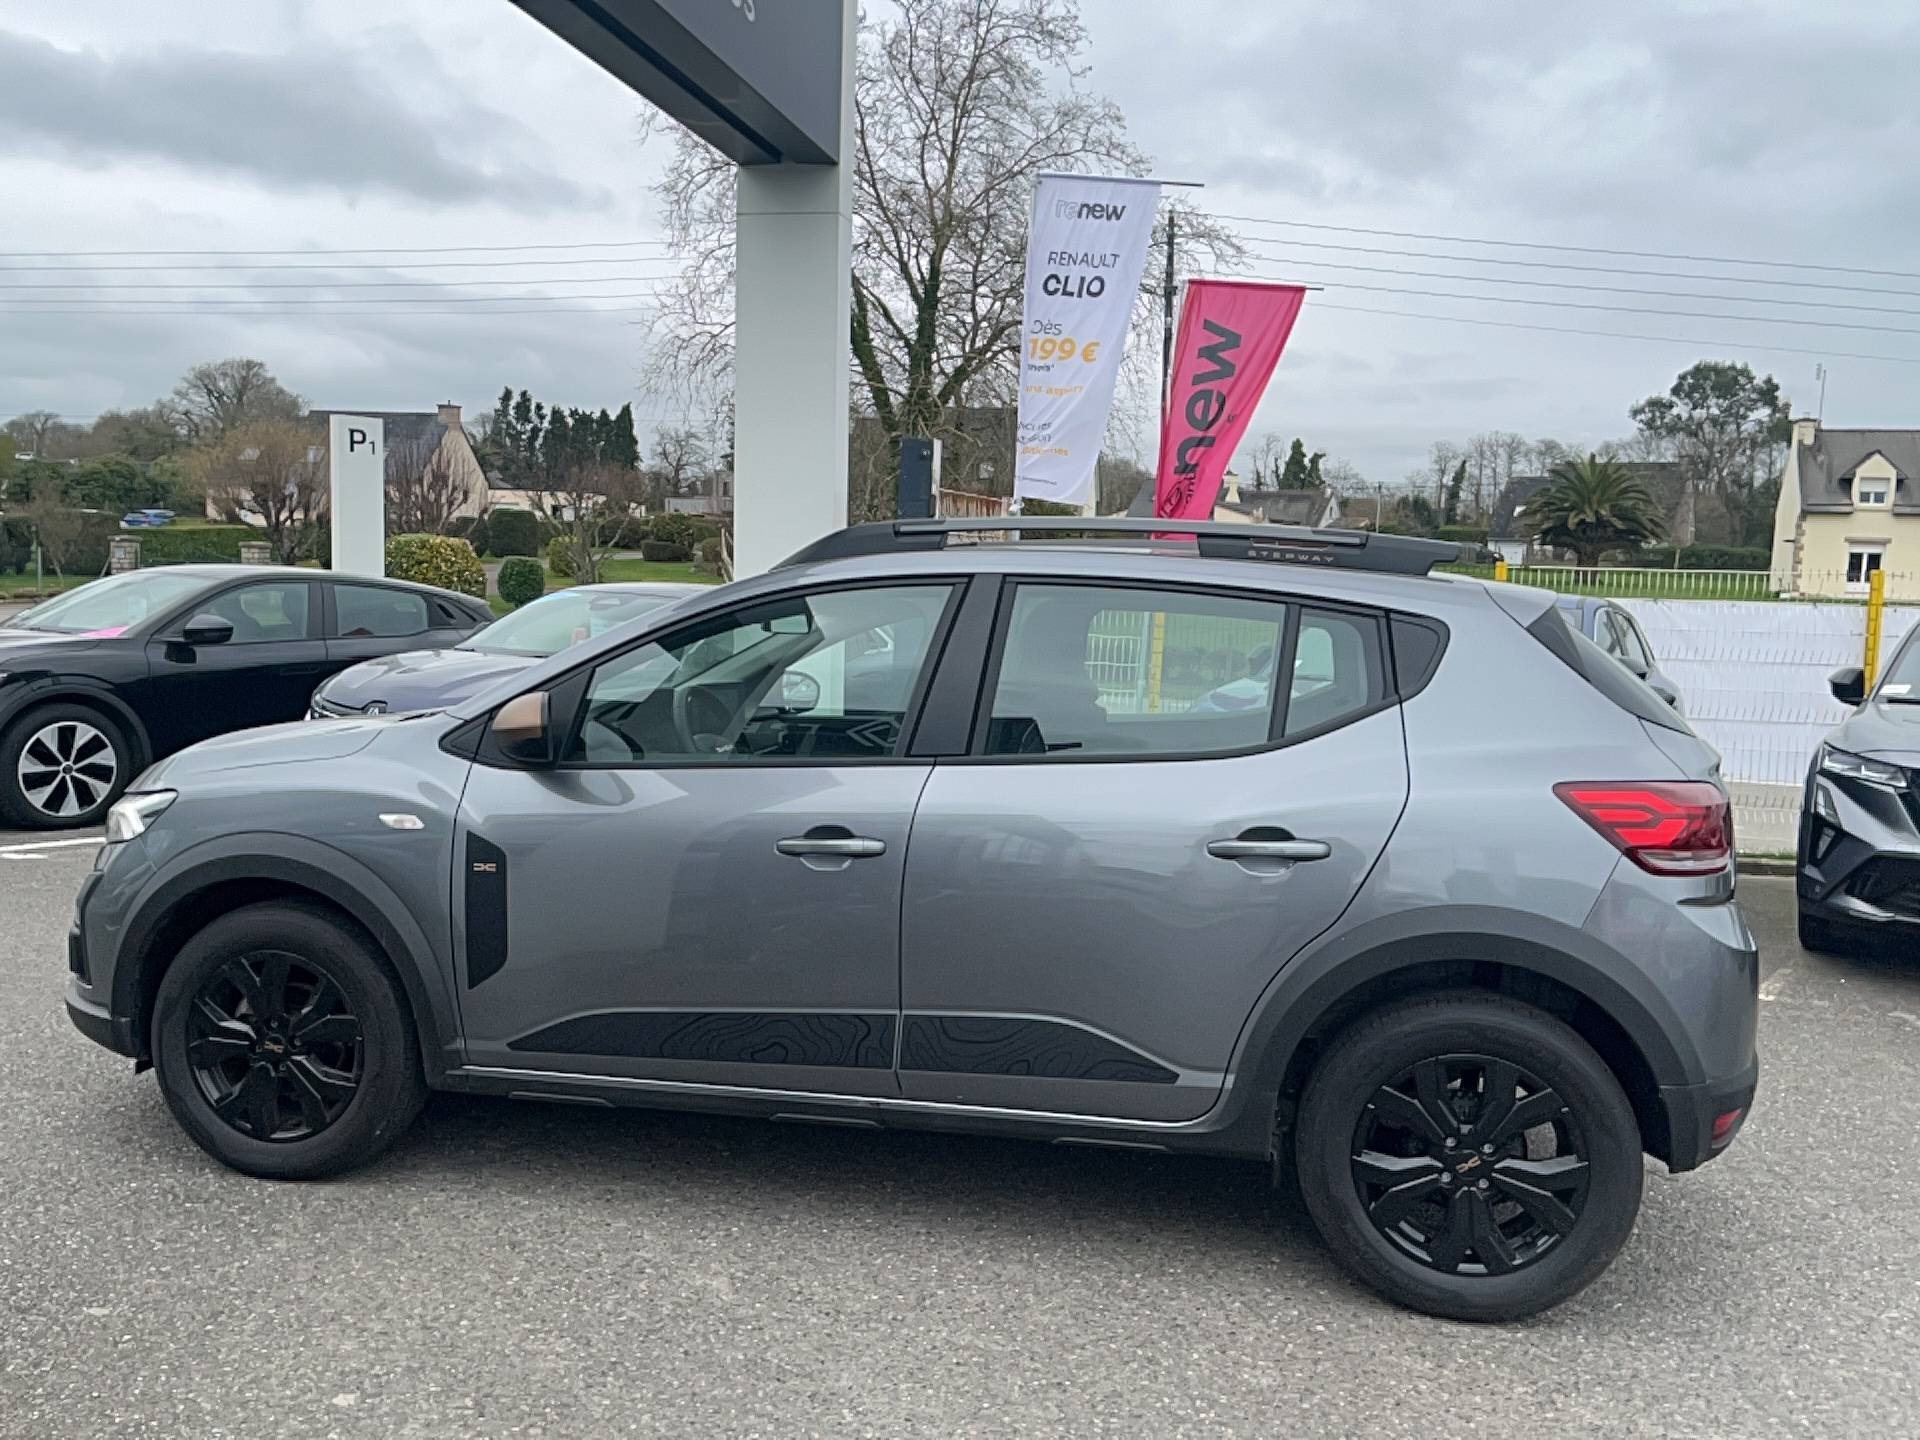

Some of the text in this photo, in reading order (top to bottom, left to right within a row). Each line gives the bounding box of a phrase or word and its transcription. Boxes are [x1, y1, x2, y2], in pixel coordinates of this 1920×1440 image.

[1055, 199, 1127, 221] renew
[1047, 250, 1121, 269] RENAULT
[1042, 273, 1106, 298] CLIO
[1029, 337, 1101, 363] 199 €
[1247, 550, 1335, 563] STEPWAY
